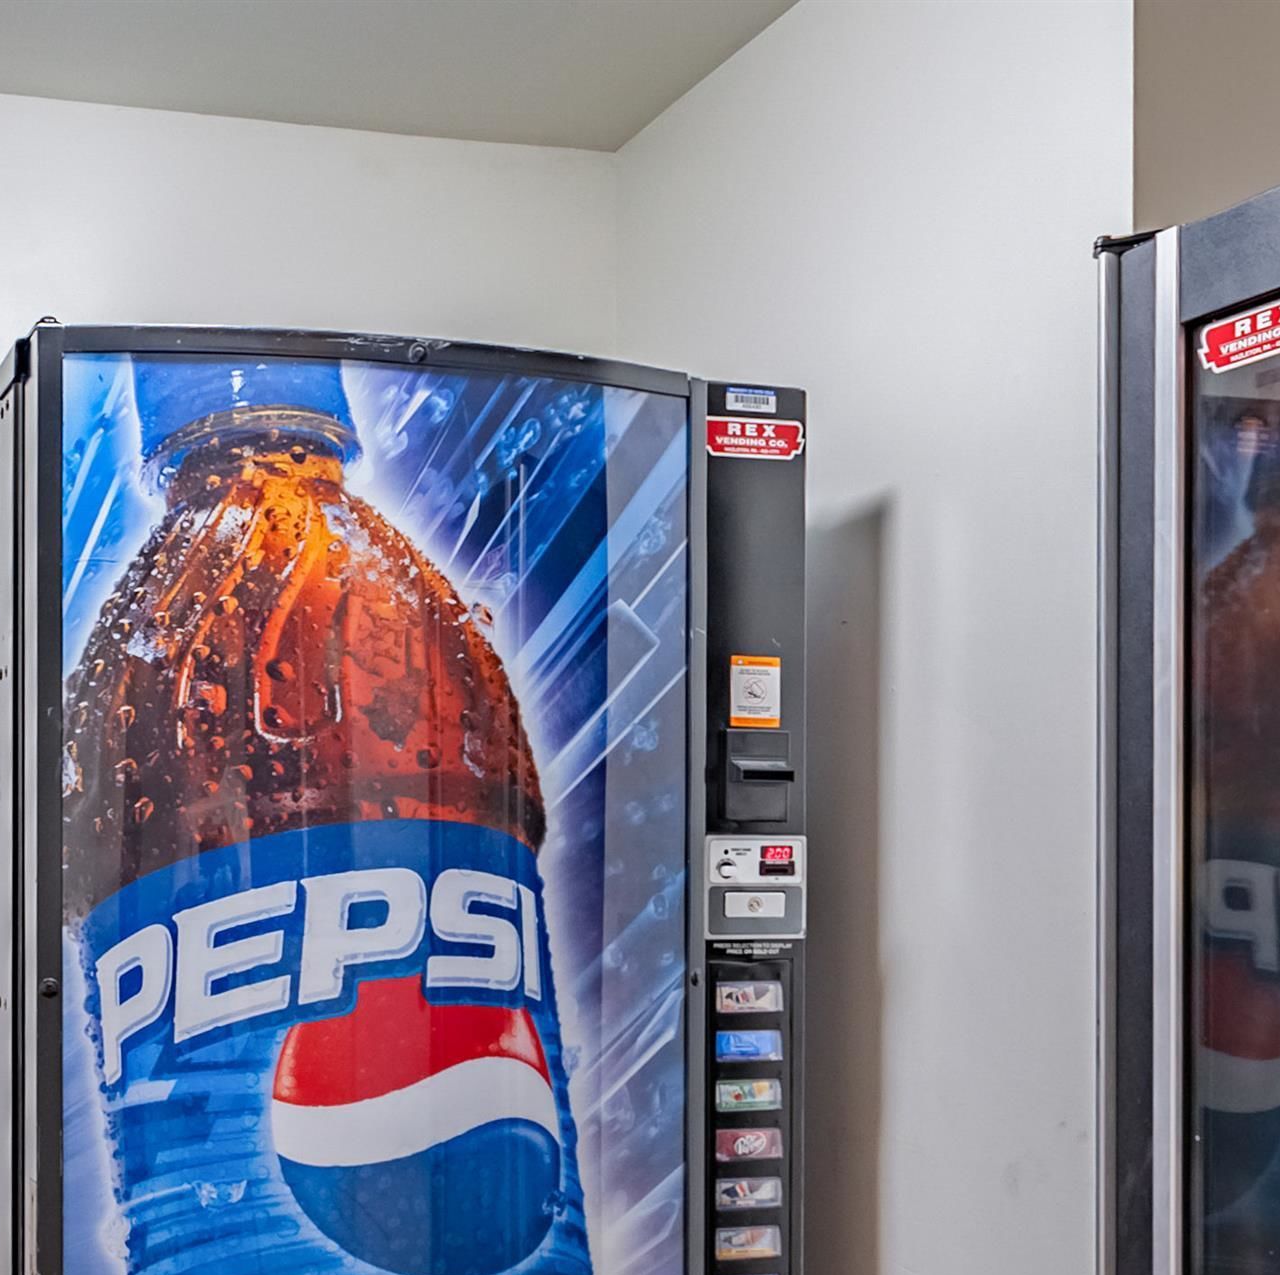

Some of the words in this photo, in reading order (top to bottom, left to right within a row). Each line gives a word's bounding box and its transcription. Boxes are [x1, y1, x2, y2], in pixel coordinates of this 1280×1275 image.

[727, 423, 776, 438] REX
[716, 436, 766, 447] VENDING
[768, 440, 788, 448] CO.
[95, 866, 542, 1087] PEPSI
